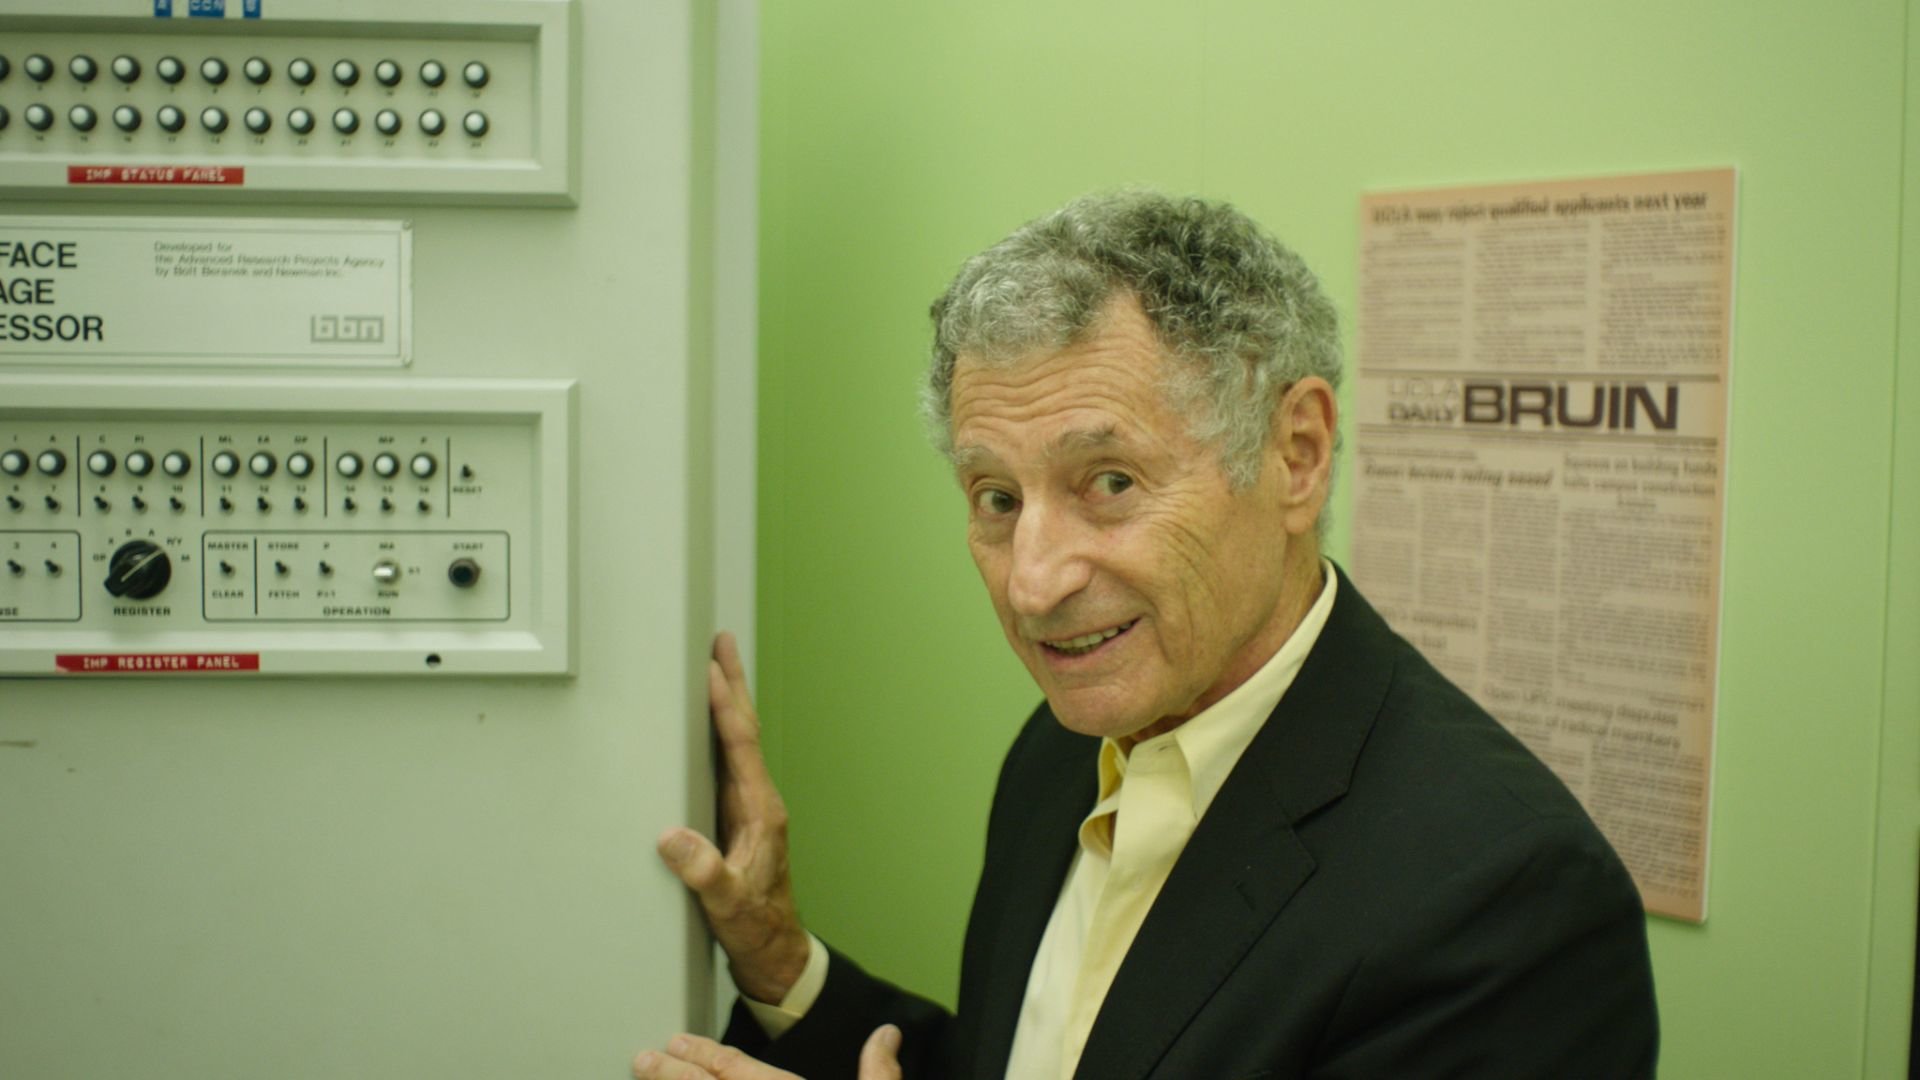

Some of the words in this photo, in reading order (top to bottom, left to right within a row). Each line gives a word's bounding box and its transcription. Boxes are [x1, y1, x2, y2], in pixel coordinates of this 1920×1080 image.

[86, 169, 112, 181] IMP
[121, 169, 174, 181] STATUS
[183, 169, 225, 182] PANEL
[1490, 196, 1551, 220] qualified
[1555, 191, 1630, 216] applicants
[1633, 193, 1669, 210] next
[1672, 193, 1708, 213] year
[154, 240, 213, 254] Developed
[217, 240, 232, 252] for
[155, 253, 173, 265] the
[178, 254, 233, 265] Advanced
[238, 254, 290, 266] Research
[295, 254, 339, 268] Projects
[344, 255, 385, 269] Agency
[155, 266, 168, 278] by
[173, 266, 197, 277] Bolt
[202, 266, 247, 278] Beranek
[252, 266, 272, 277] and
[276, 266, 323, 278] Newman
[1464, 380, 1679, 430] BRUIN
[1388, 402, 1459, 422] DAILY
[452, 485, 482, 494] RESET
[207, 542, 249, 551] MASTER
[267, 542, 299, 550] STORE
[452, 542, 484, 551] START
[211, 589, 244, 599] CLEAR
[268, 589, 300, 599] FETCH
[377, 589, 399, 598] RUN
[113, 605, 171, 617] REGISTER
[322, 606, 391, 617] OPERATION
[83, 657, 108, 669] IMP
[118, 657, 187, 669] REGISTER
[197, 656, 239, 668] PANEL
